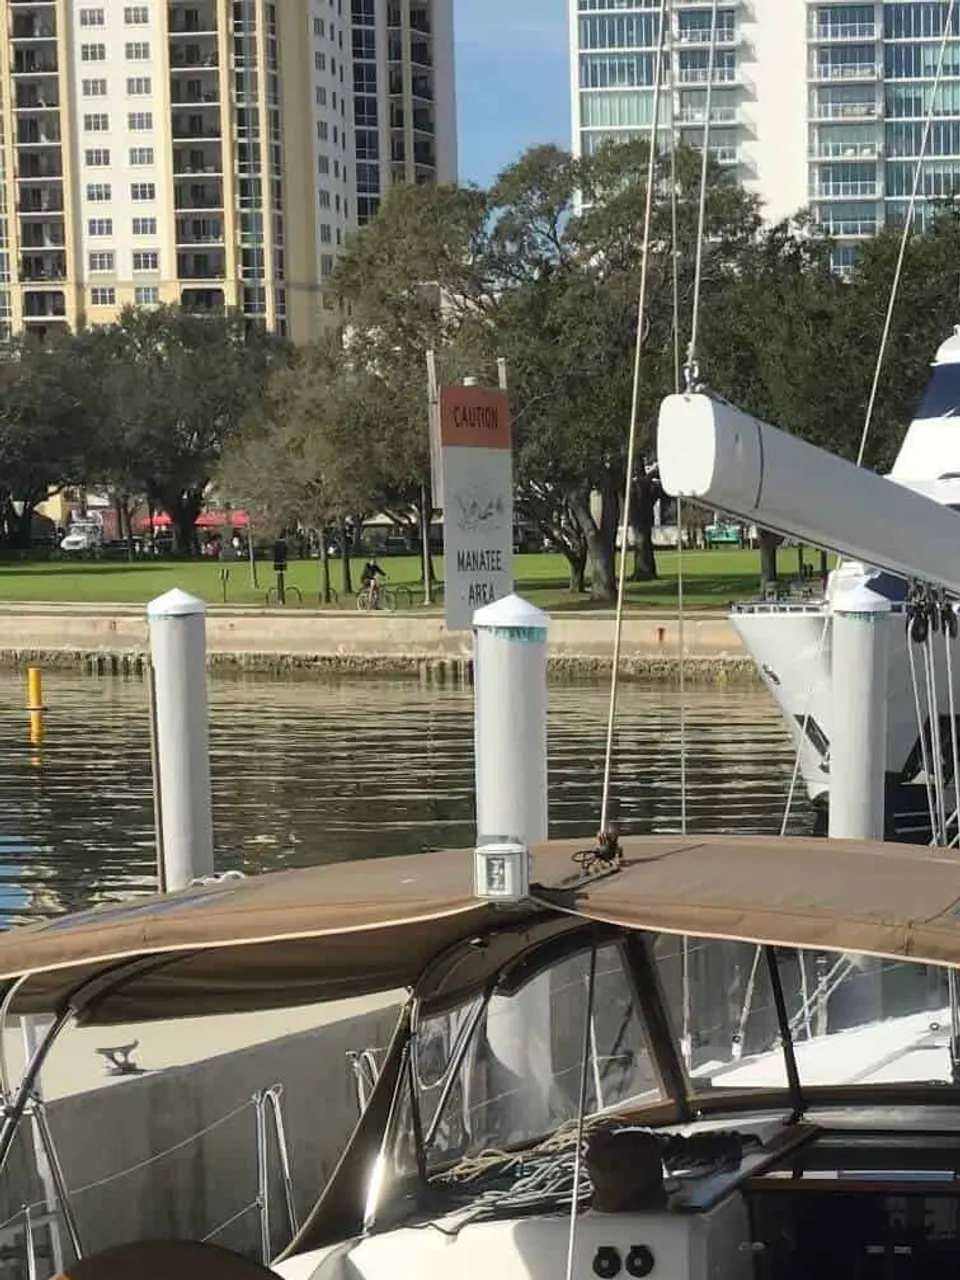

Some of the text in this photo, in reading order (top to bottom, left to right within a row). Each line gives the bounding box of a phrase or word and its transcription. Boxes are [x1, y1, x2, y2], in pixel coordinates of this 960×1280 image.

[453, 405, 499, 429] CAUTION
[457, 550, 502, 573] MANATEE
[468, 584, 496, 607] AREA
